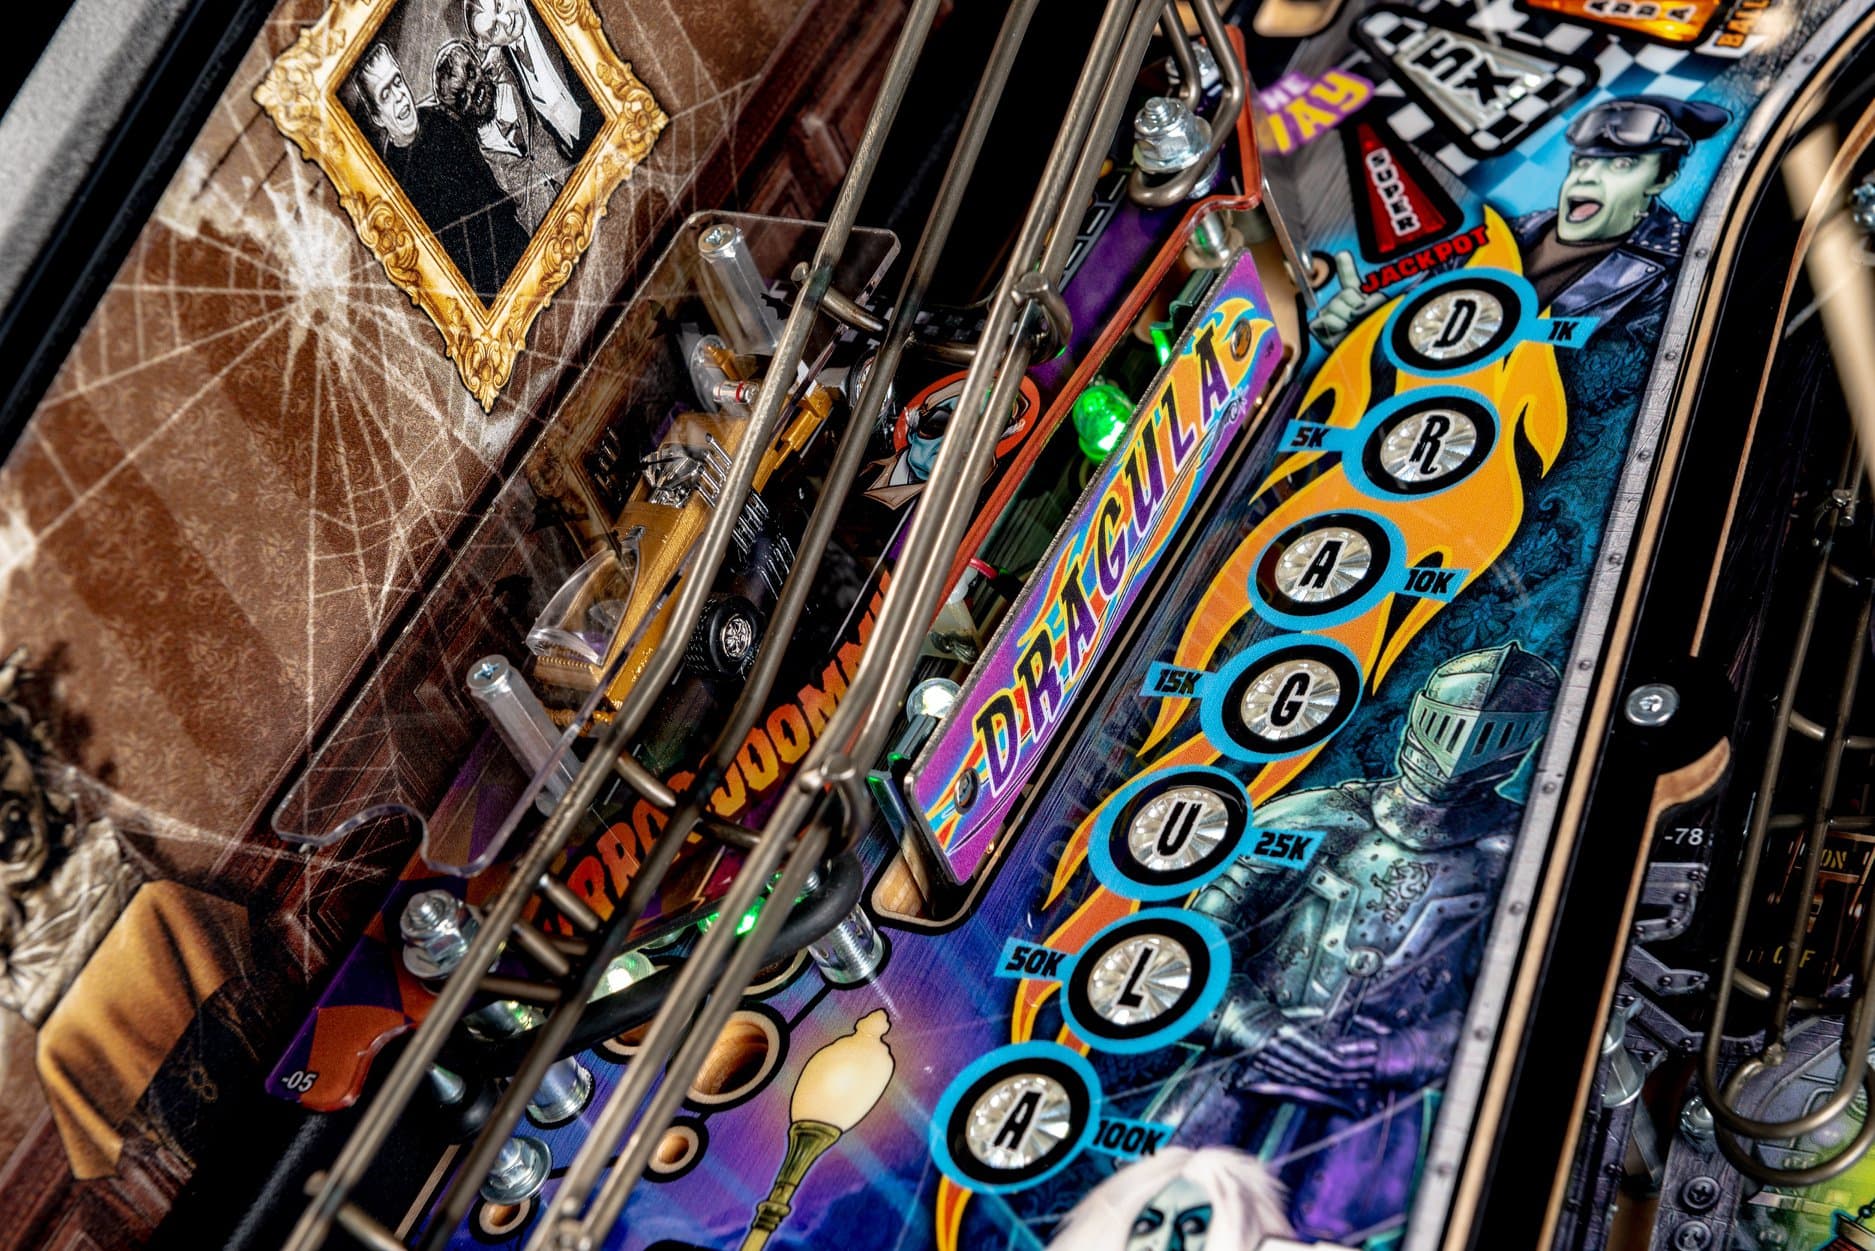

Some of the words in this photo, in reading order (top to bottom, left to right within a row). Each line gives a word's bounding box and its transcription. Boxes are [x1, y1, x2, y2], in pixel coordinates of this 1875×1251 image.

[1258, 72, 1312, 112] HE
[1409, 37, 1518, 106] 5X
[1368, 150, 1419, 235] SUPER
[1360, 224, 1490, 293] JACKPOT
[1432, 298, 1478, 349] D
[1549, 320, 1580, 342] 1K
[1290, 427, 1329, 449] 5K
[1408, 414, 1450, 475] R
[974, 322, 1232, 796] DRAGULA
[1298, 540, 1346, 589] A
[1404, 567, 1455, 595] 10K
[1153, 668, 1203, 695] 15K
[1269, 672, 1312, 727] G
[1156, 801, 1203, 857] U
[1253, 831, 1314, 861] 25K
[1664, 828, 1704, 846] -78
[1004, 946, 1067, 977] 50K
[1117, 946, 1154, 1008] L
[281, 1070, 318, 1093] -05
[992, 1089, 1044, 1150] A
[1092, 1118, 1167, 1157] 100K
